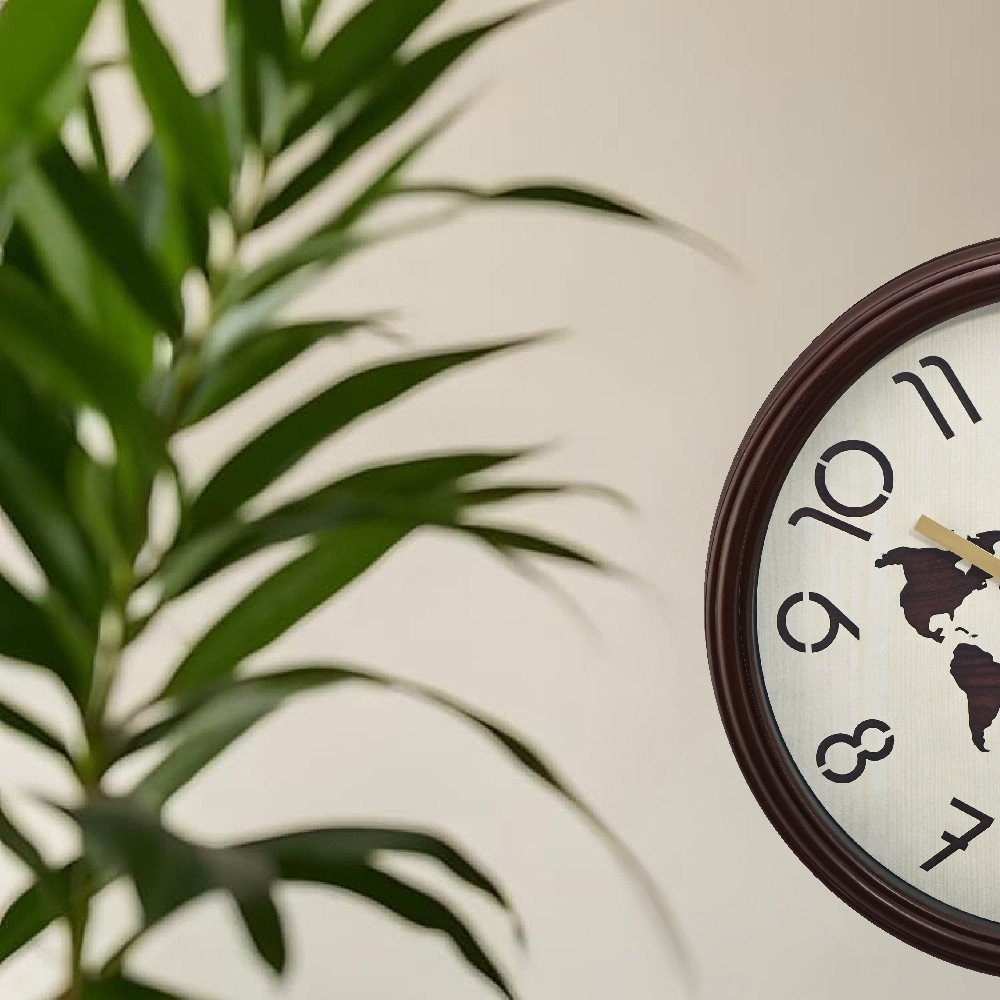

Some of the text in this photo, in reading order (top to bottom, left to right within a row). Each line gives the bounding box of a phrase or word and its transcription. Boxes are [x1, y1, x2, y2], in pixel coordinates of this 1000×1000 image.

[892, 355, 983, 440] 11
[788, 439, 894, 541] 10
[776, 591, 861, 654] 9
[815, 718, 895, 784] 8
[919, 797, 995, 873] 7
